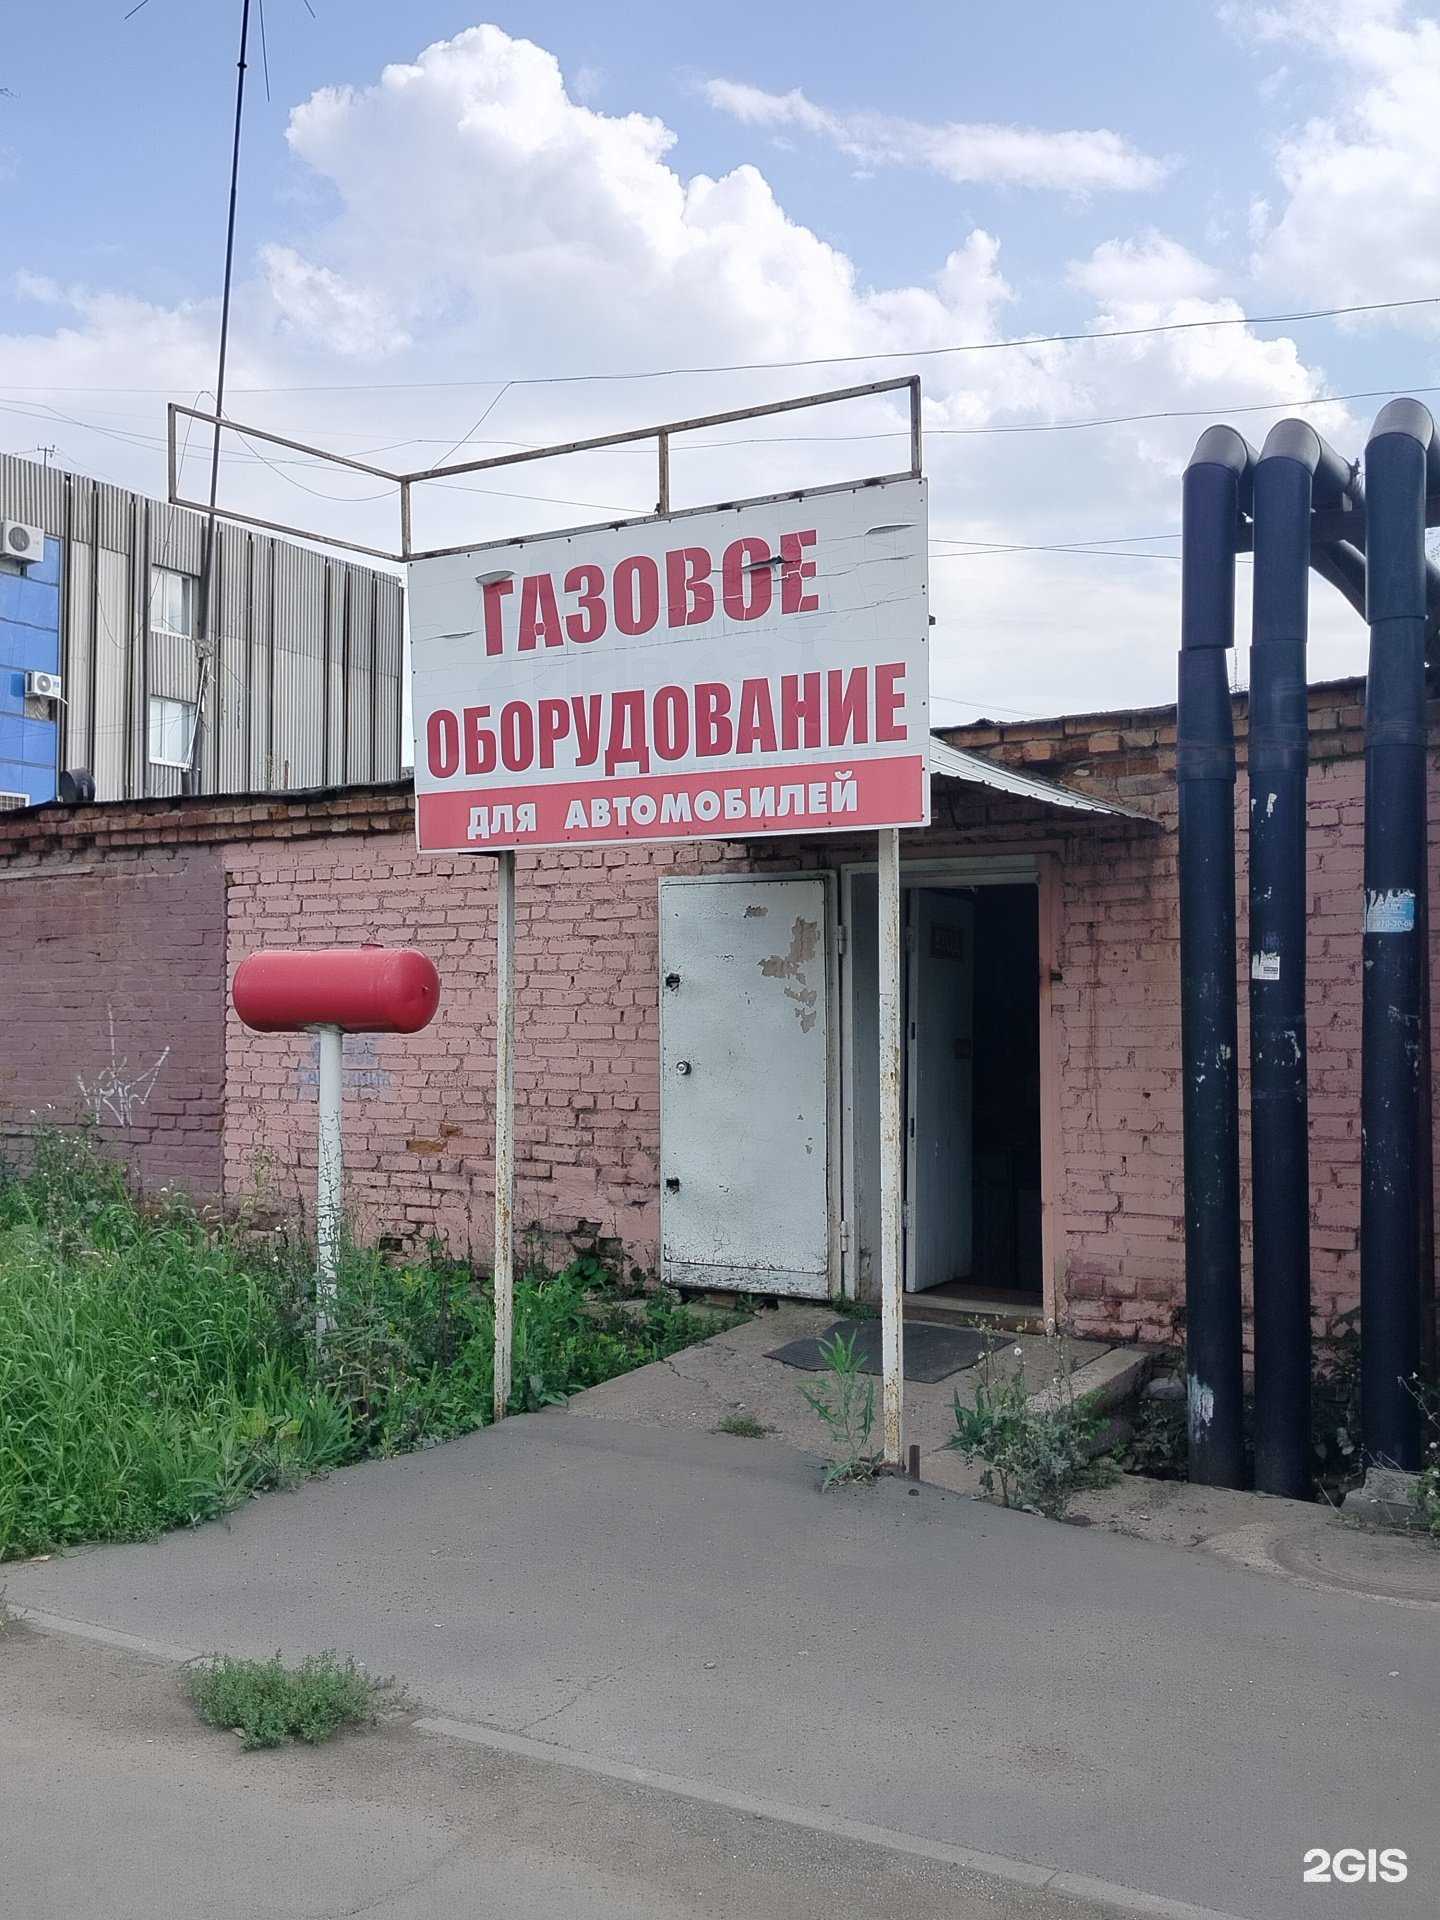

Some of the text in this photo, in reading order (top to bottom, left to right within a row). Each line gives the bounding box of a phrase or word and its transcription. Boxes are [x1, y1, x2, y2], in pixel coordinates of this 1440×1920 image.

[483, 529, 819, 656] ГАЗОВОЕ
[427, 662, 908, 777] ОБОРУДОВАНИЕ
[467, 770, 858, 840] ДЛЯ АВТОМОБИЛЕЙ
